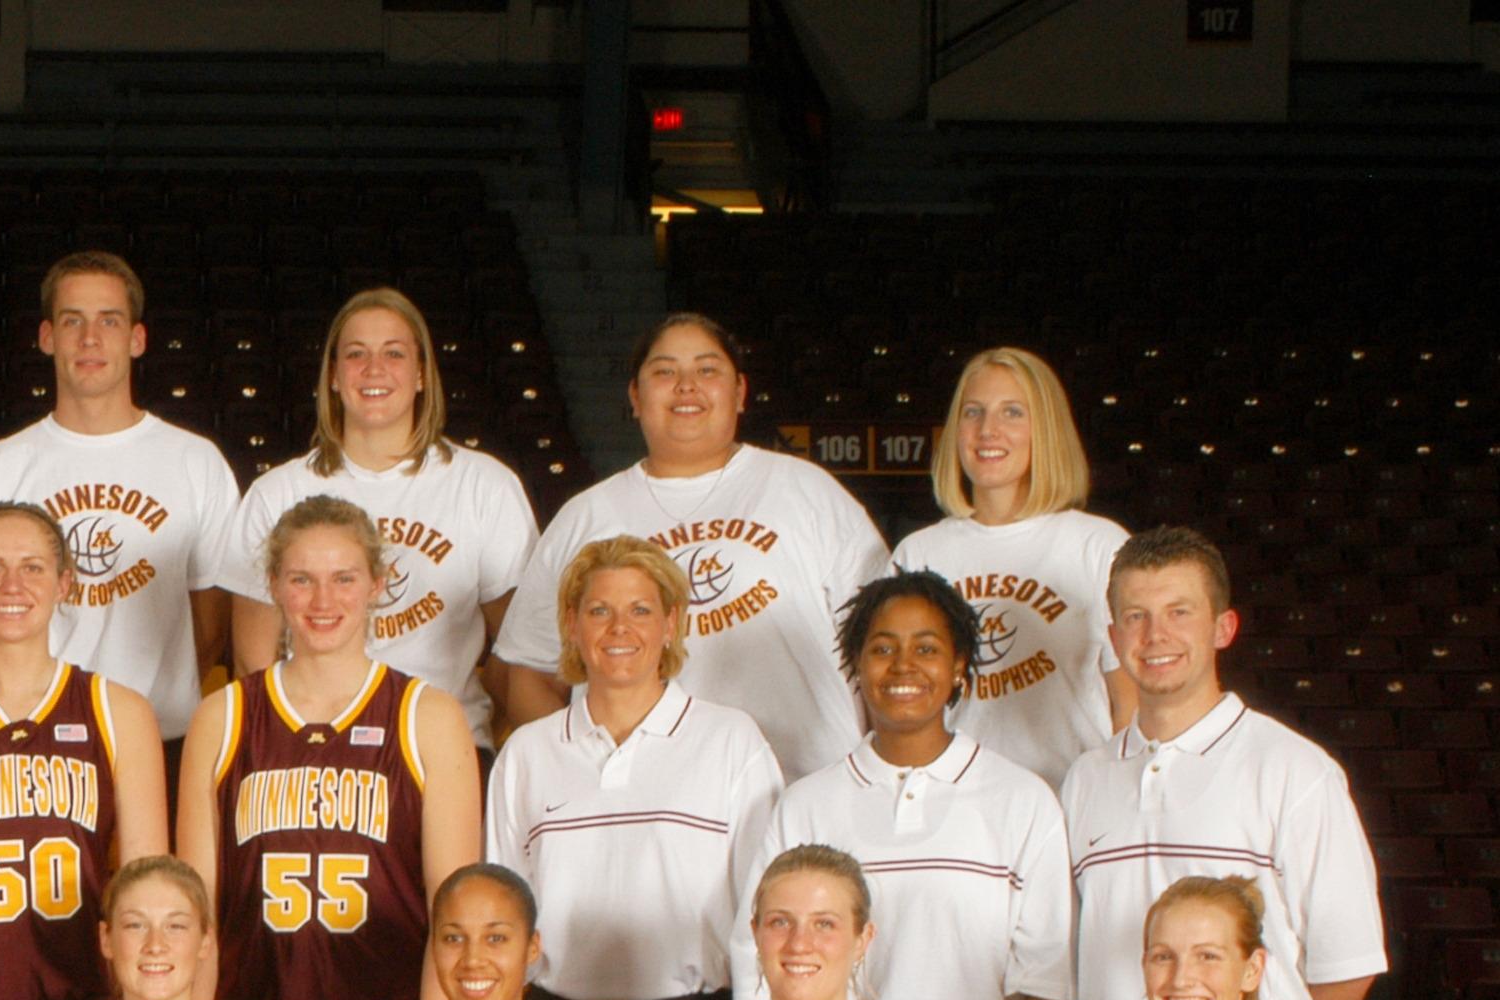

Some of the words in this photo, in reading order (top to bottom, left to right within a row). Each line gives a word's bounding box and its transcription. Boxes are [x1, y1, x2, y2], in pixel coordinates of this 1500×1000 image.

[1199, 7, 1240, 33] 107
[817, 434, 861, 463] 106
[881, 434, 925, 463] 107
[44, 484, 169, 533] INNESOTA
[377, 517, 454, 564] ESOTA
[648, 518, 779, 553] NNESOTA
[87, 558, 156, 607] GOPHERS
[954, 574, 1068, 624] NESOTA
[374, 590, 445, 640] GOPHERS
[697, 578, 779, 637] GOPHERS
[976, 650, 1057, 700] GOPHERS
[235, 766, 389, 846] MINNESOTA
[262, 852, 369, 933] 55
